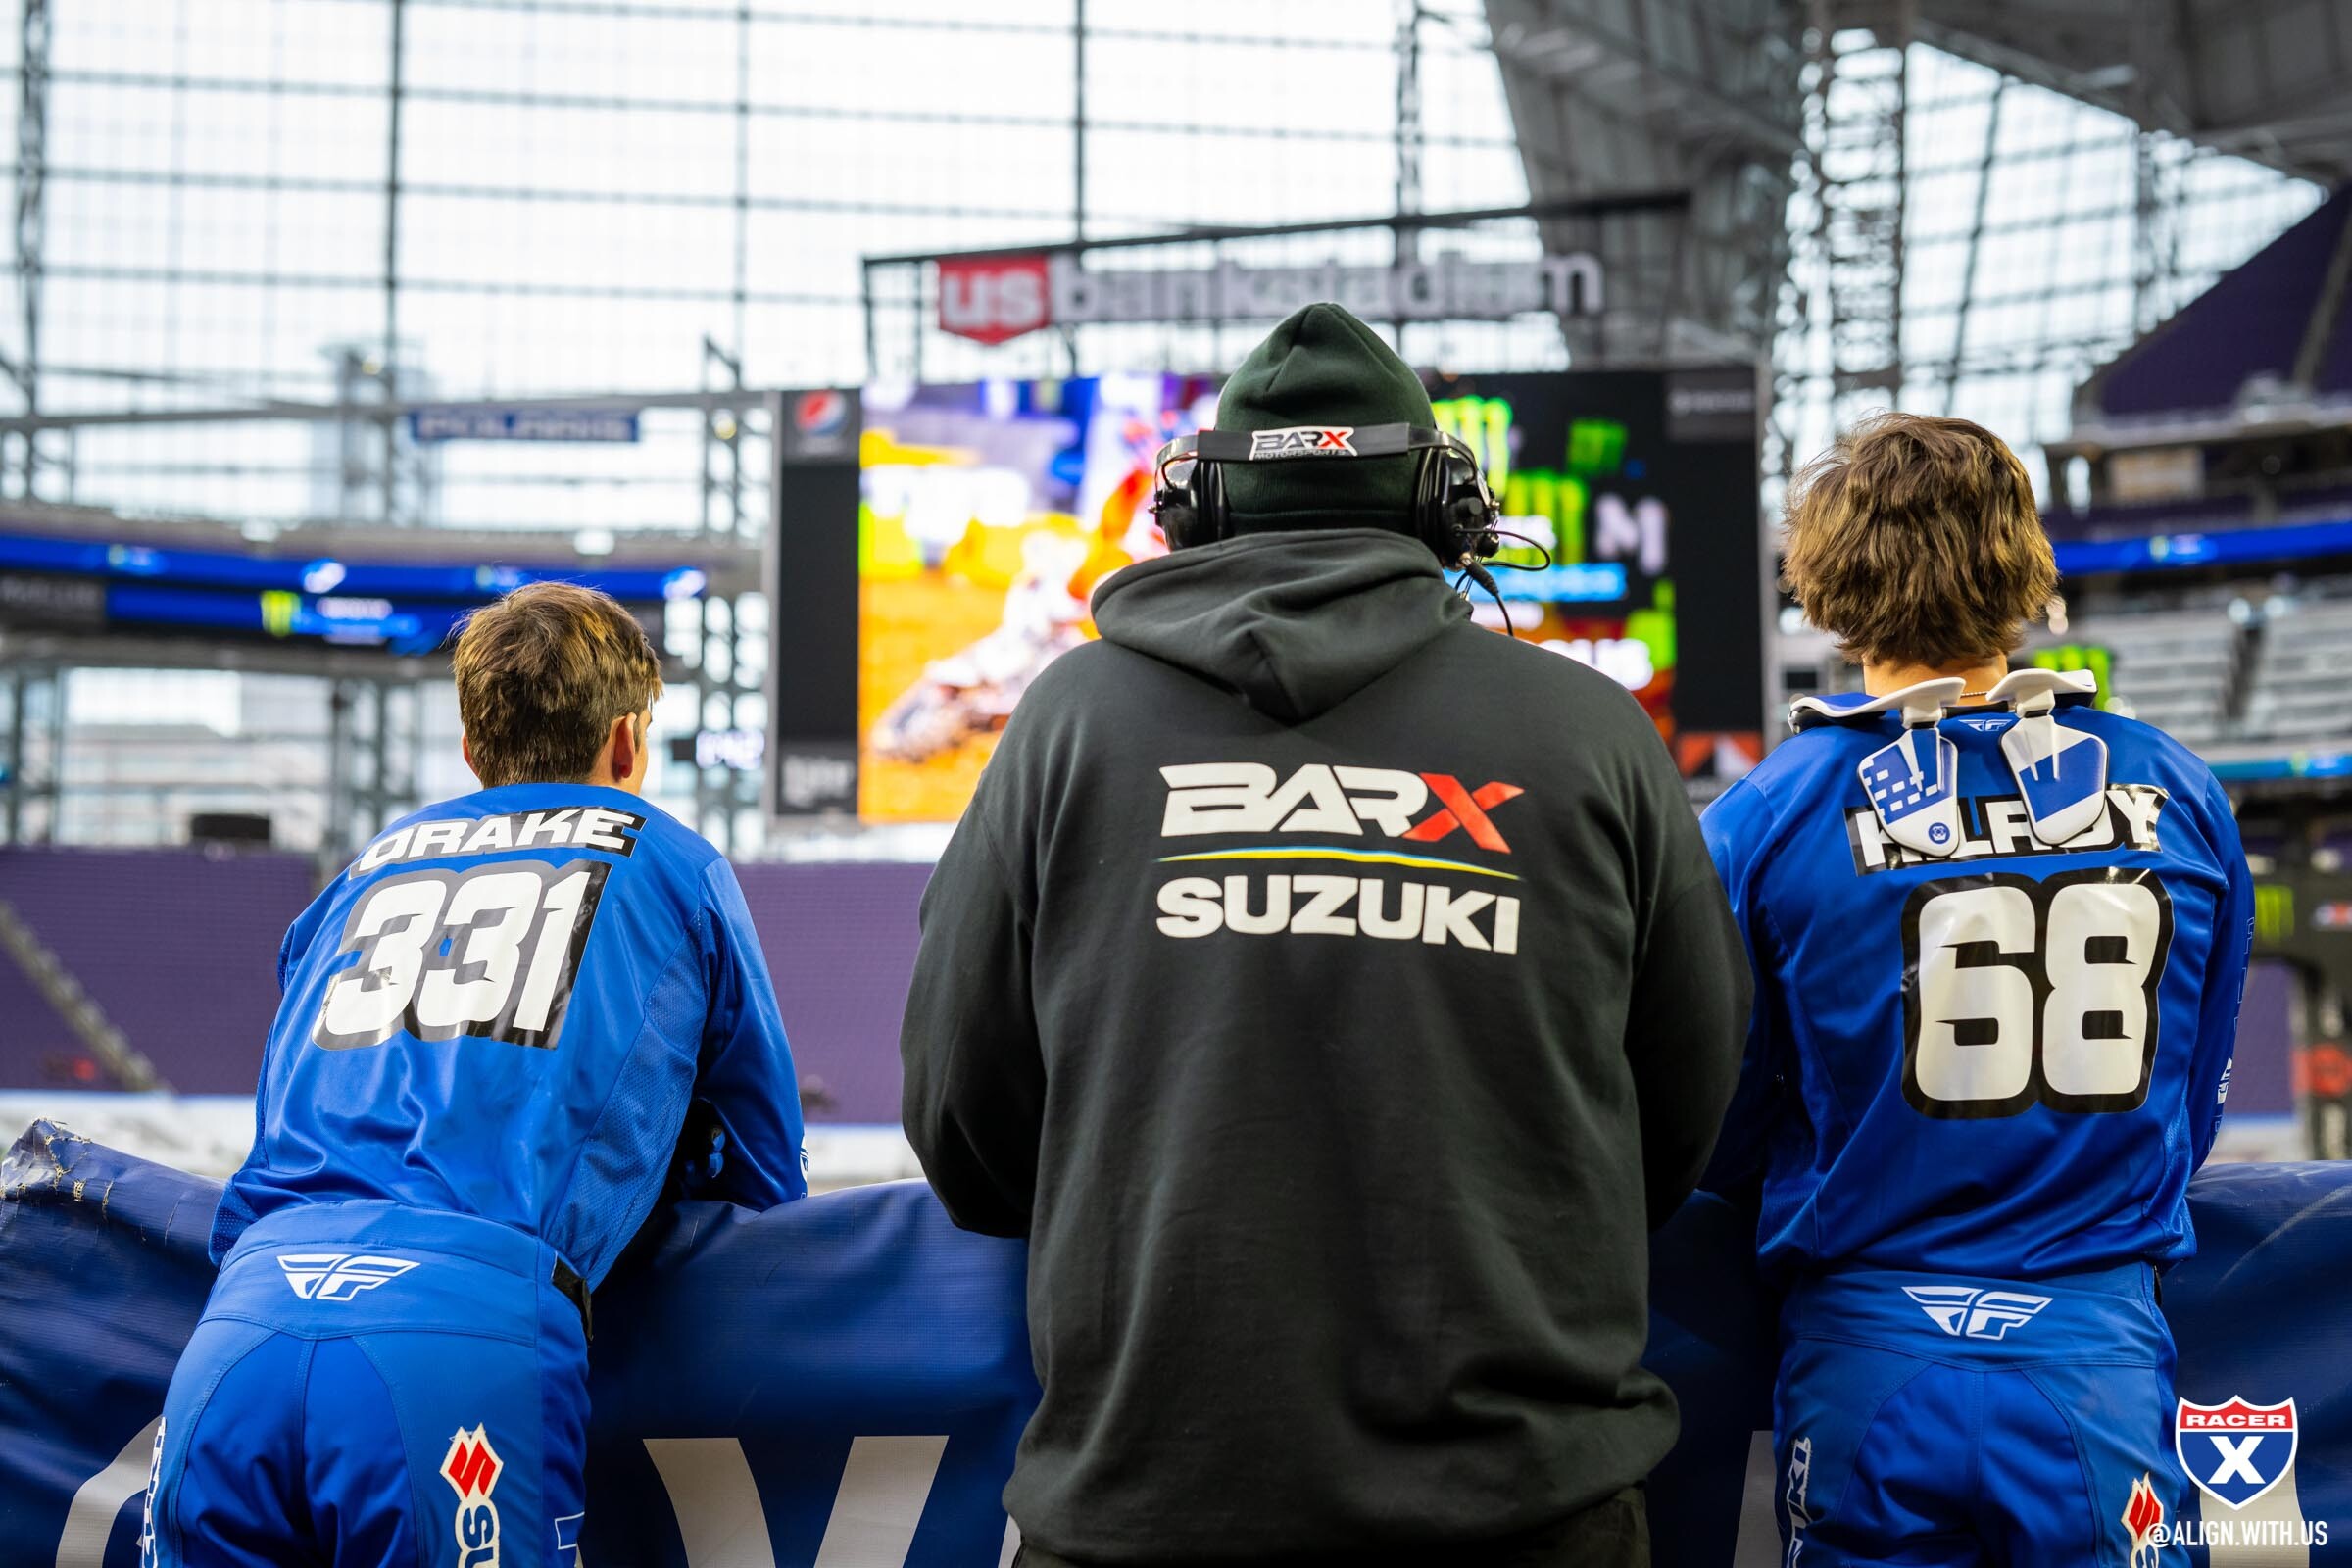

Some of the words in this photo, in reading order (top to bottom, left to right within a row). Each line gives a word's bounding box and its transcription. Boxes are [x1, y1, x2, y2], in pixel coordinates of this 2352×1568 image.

[942, 270, 1045, 326] us
[1255, 431, 1348, 449] BARX
[359, 808, 636, 871] DRAKE
[1158, 761, 1526, 855] BARX
[325, 870, 592, 1036] 331
[1155, 874, 1521, 956] SUZUKI
[1915, 882, 2162, 1101] 68
